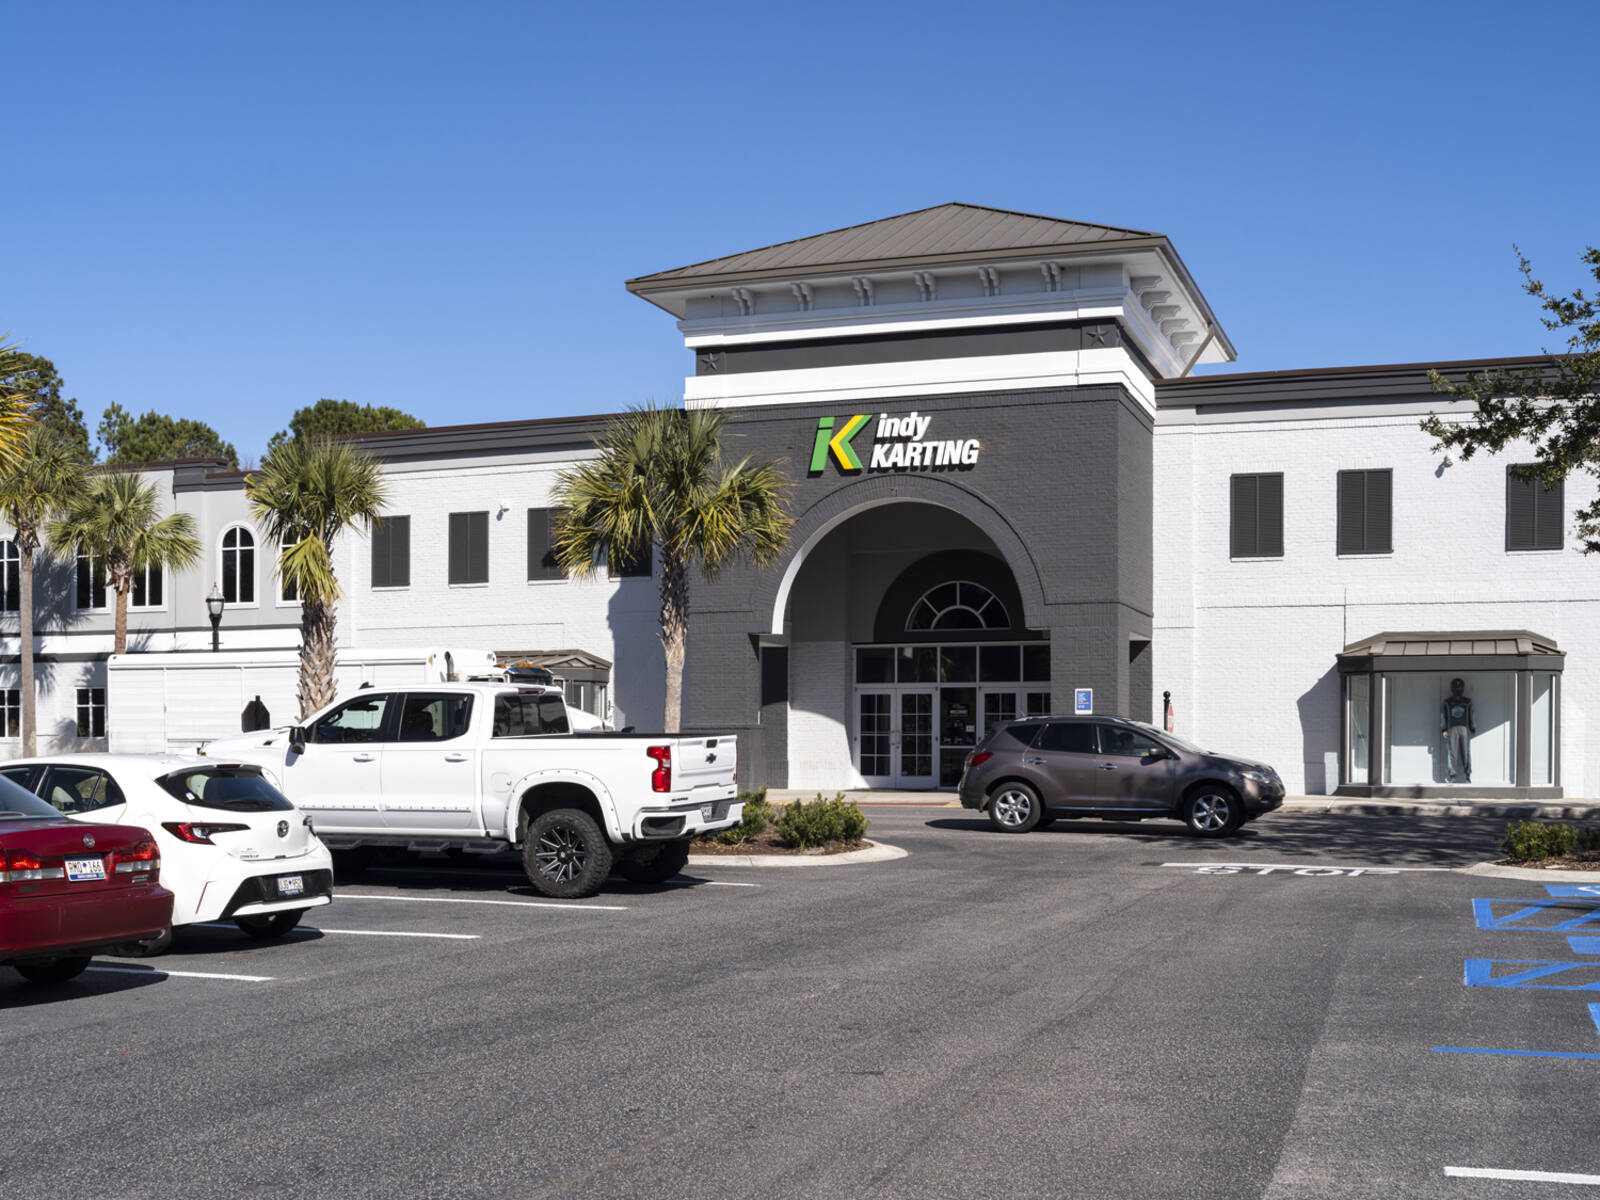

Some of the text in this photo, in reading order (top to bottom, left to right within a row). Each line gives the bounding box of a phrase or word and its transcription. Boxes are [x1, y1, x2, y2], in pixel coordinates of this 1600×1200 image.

[876, 411, 932, 441] indy
[869, 439, 981, 469] KARTING
[1192, 865, 1400, 877] STOP
